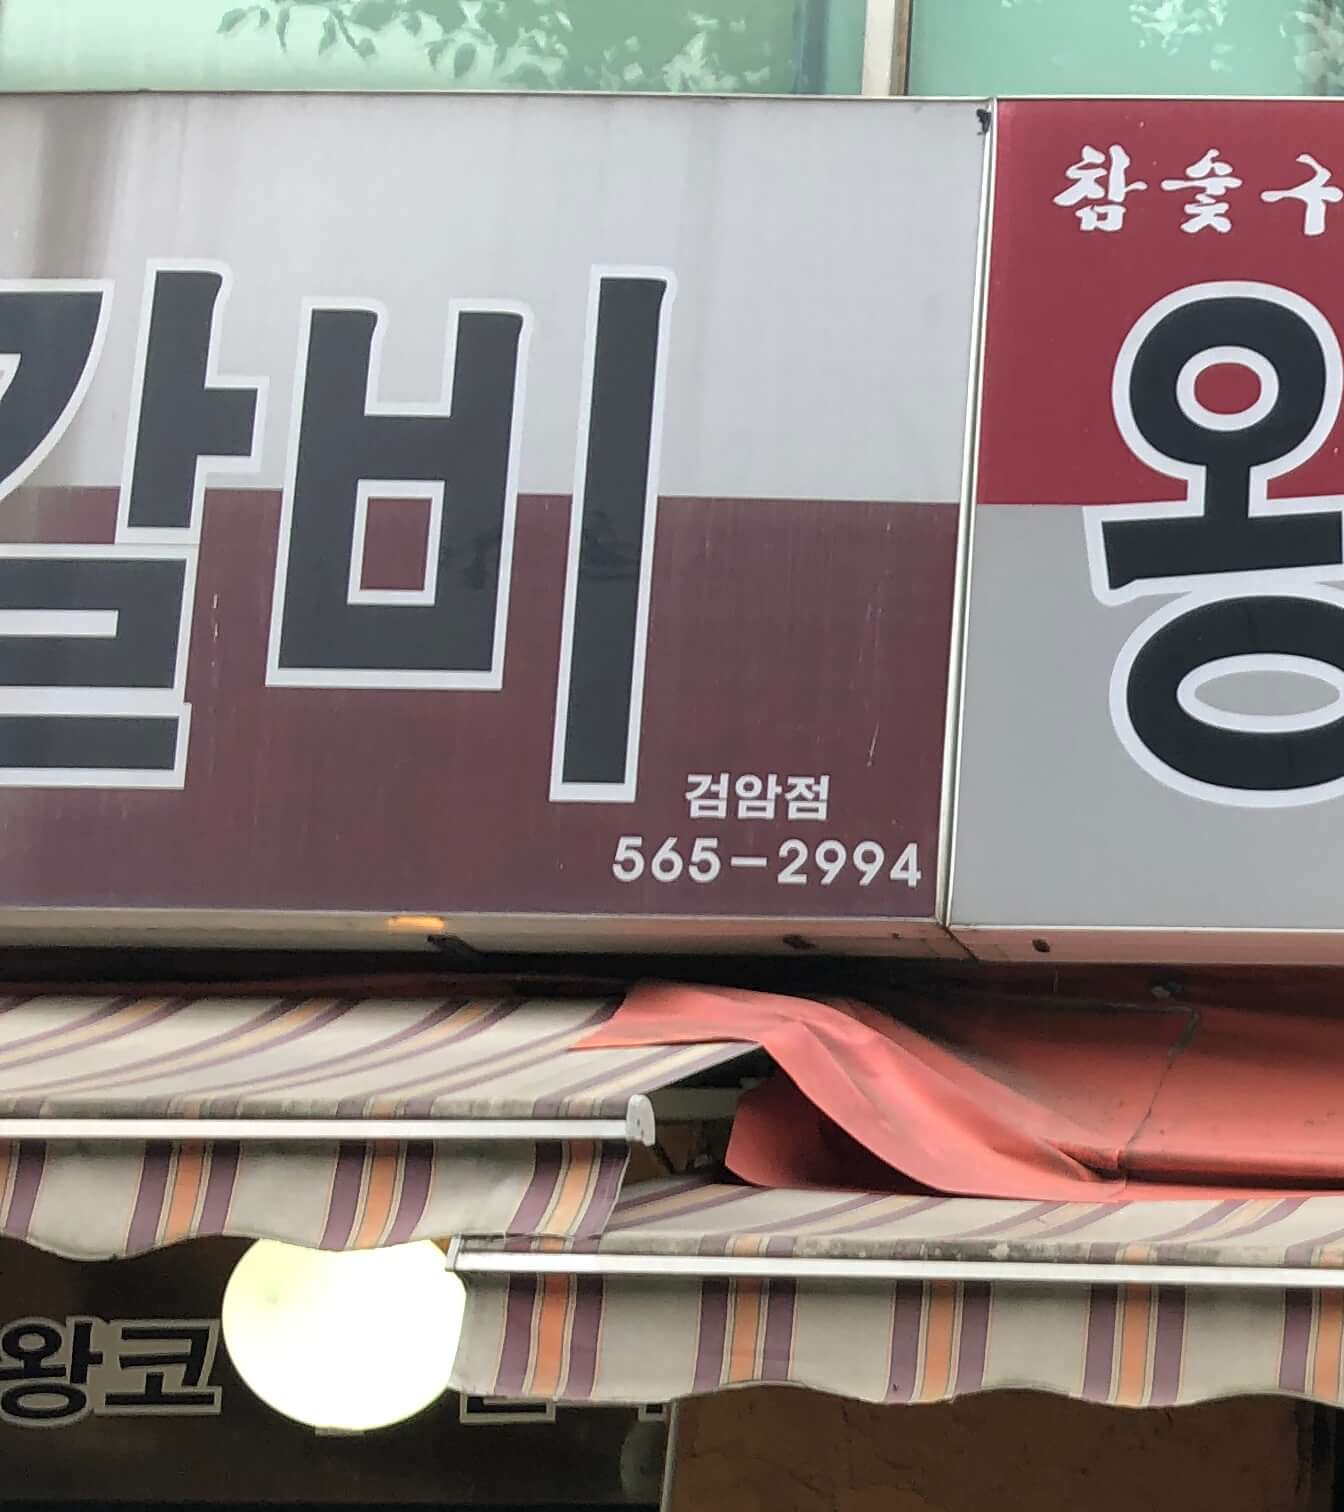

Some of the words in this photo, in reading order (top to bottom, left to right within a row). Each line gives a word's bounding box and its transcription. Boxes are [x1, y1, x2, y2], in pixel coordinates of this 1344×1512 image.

[0, 258, 676, 803] 갈비
[684, 772, 831, 823] 검암점
[611, 835, 923, 889] 565-2994
[0, 1316, 223, 1427] 왕코
